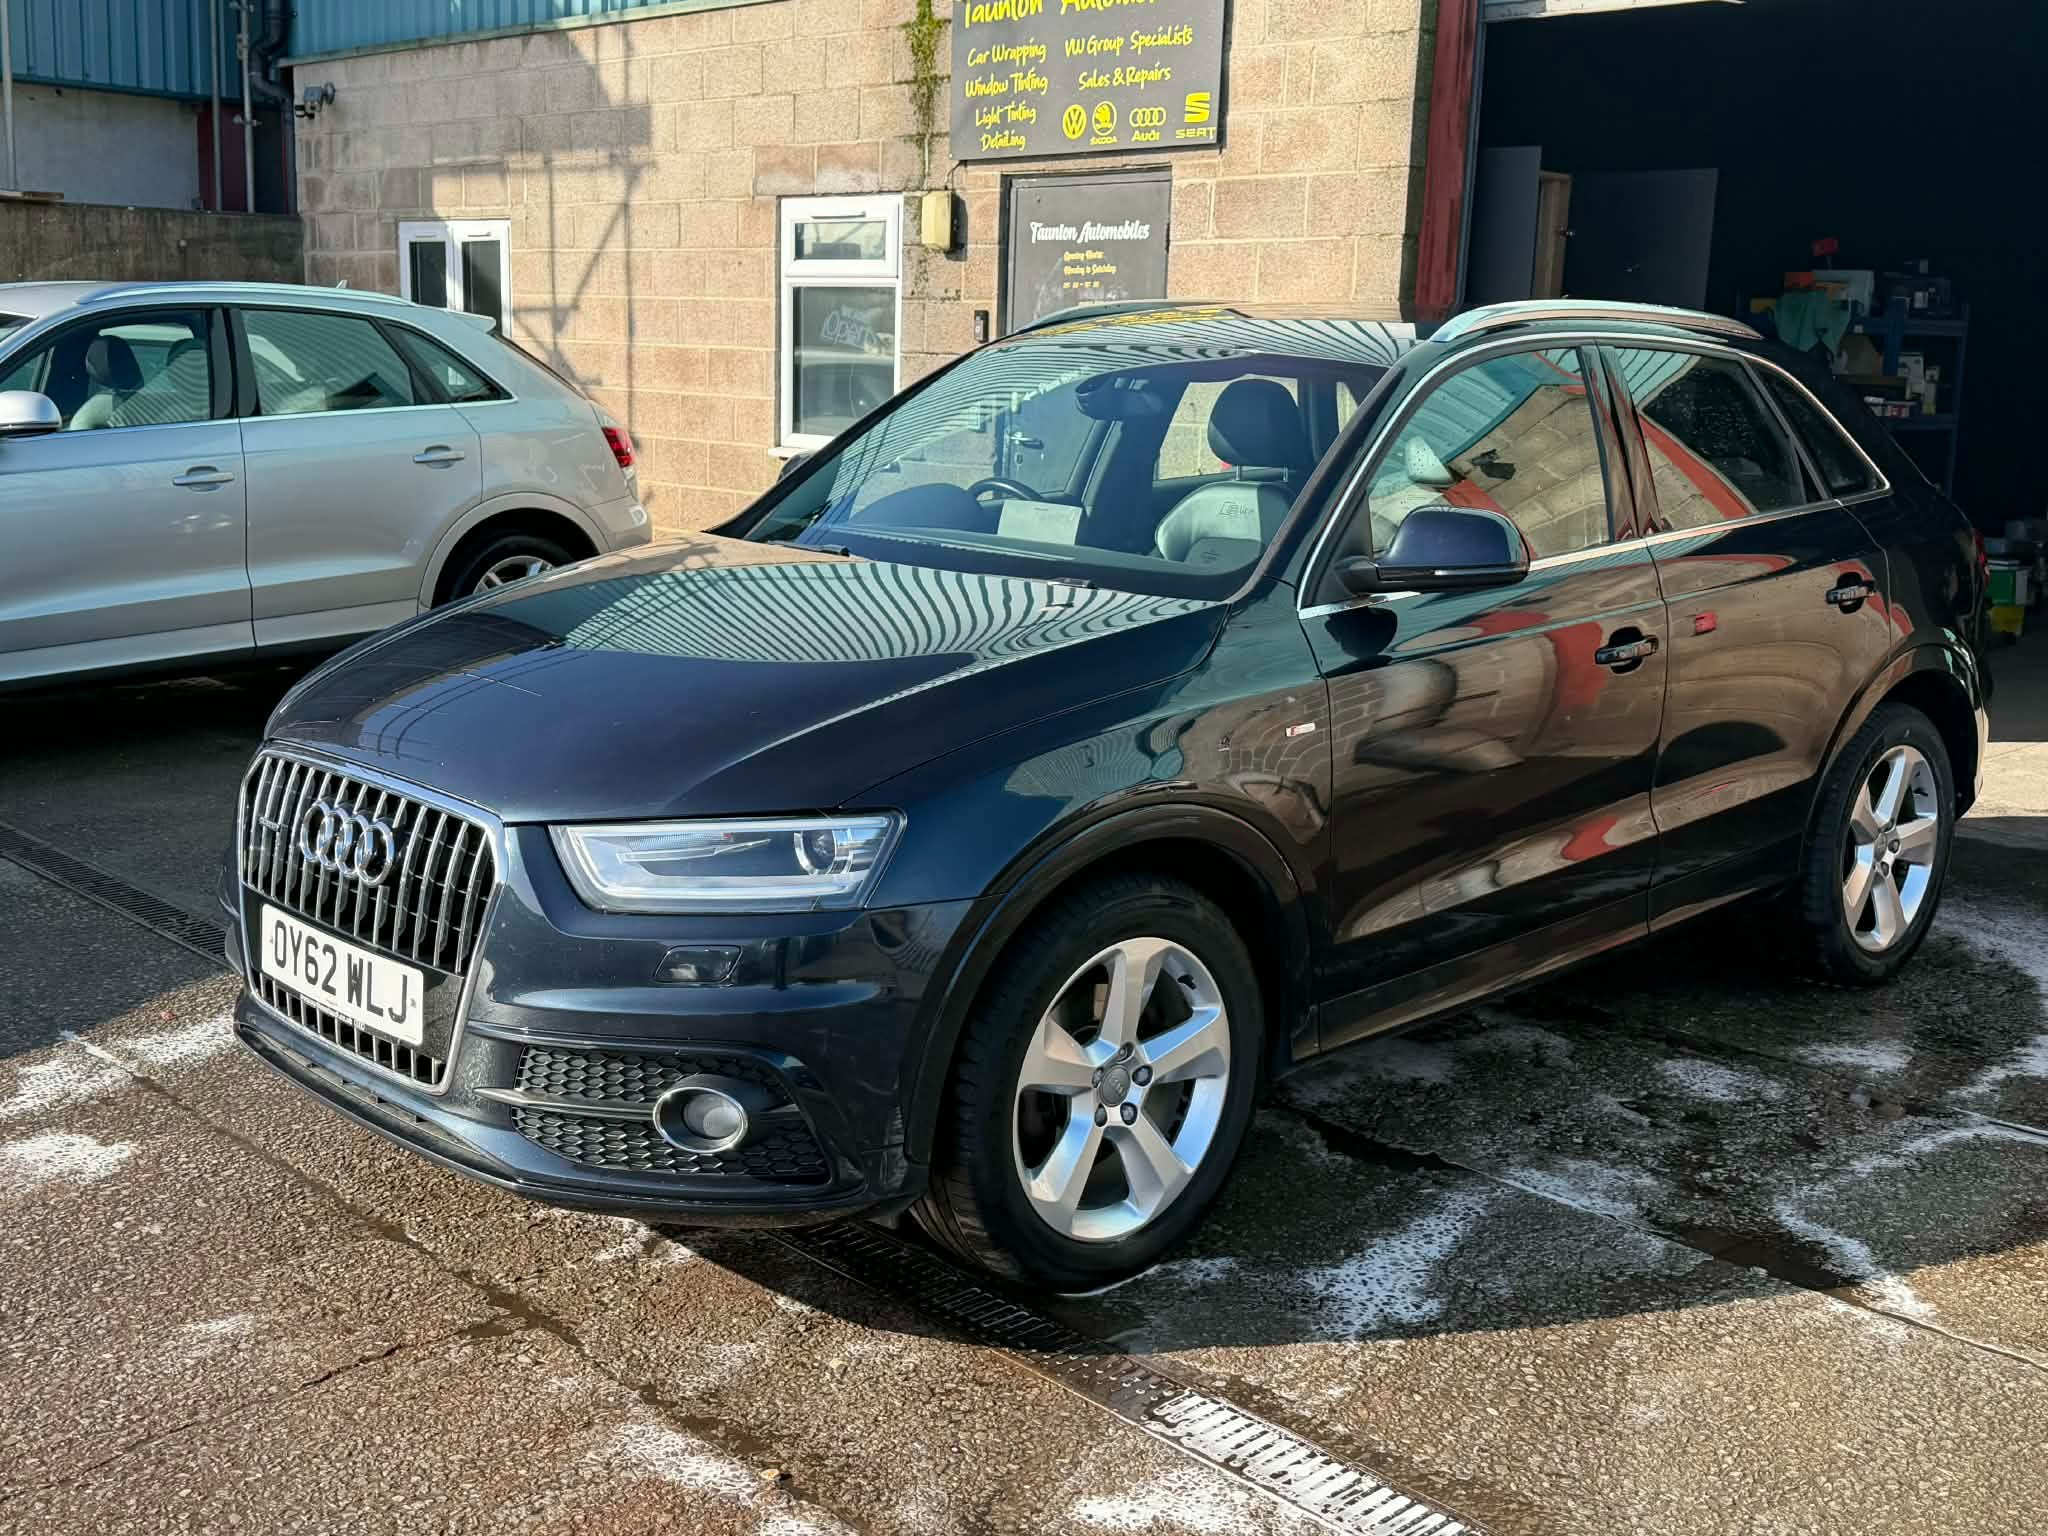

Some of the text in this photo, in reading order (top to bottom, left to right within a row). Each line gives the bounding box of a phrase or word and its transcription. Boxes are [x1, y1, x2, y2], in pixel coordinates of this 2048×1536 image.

[967, 37, 1047, 68] Car Wrapping
[1064, 24, 1192, 57] VW Group Specialists
[965, 66, 1048, 97] Window Tinting
[1078, 61, 1171, 90] Sales & Repairs
[975, 100, 1037, 129] Light Tinting
[980, 129, 1026, 152] Detailing
[1131, 129, 1161, 142] Audi
[1175, 126, 1217, 140] SEAT
[1029, 220, 1151, 244] Taunton Automobiles
[274, 919, 336, 996] OY62
[347, 953, 408, 1025] WLJ
